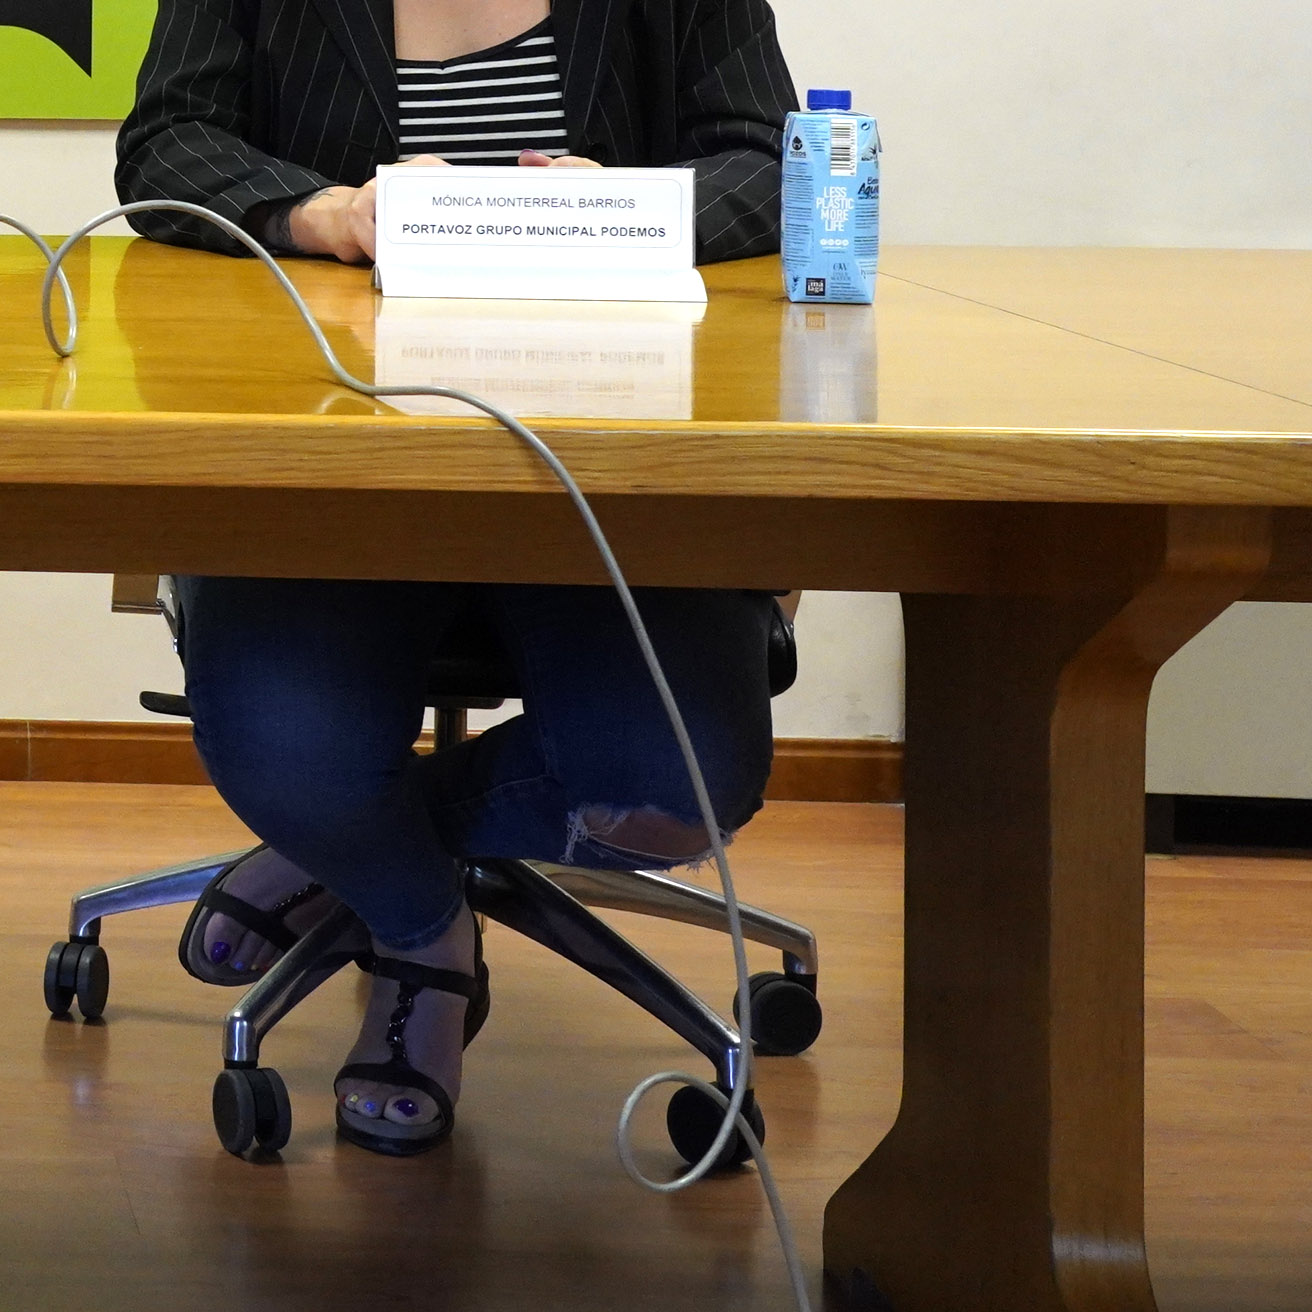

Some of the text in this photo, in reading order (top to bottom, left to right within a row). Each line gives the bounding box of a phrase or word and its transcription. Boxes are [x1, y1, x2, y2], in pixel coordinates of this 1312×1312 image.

[823, 186, 847, 198] LESS
[432, 194, 636, 209] MÓNICA MONTERREAL BARRIOS
[816, 197, 855, 209] PLASTIC
[820, 209, 849, 221] MORE
[402, 224, 666, 237] PORTAVOZ GRUPO MUNICIPAL PODEMOS
[824, 220, 844, 231] LIFE
